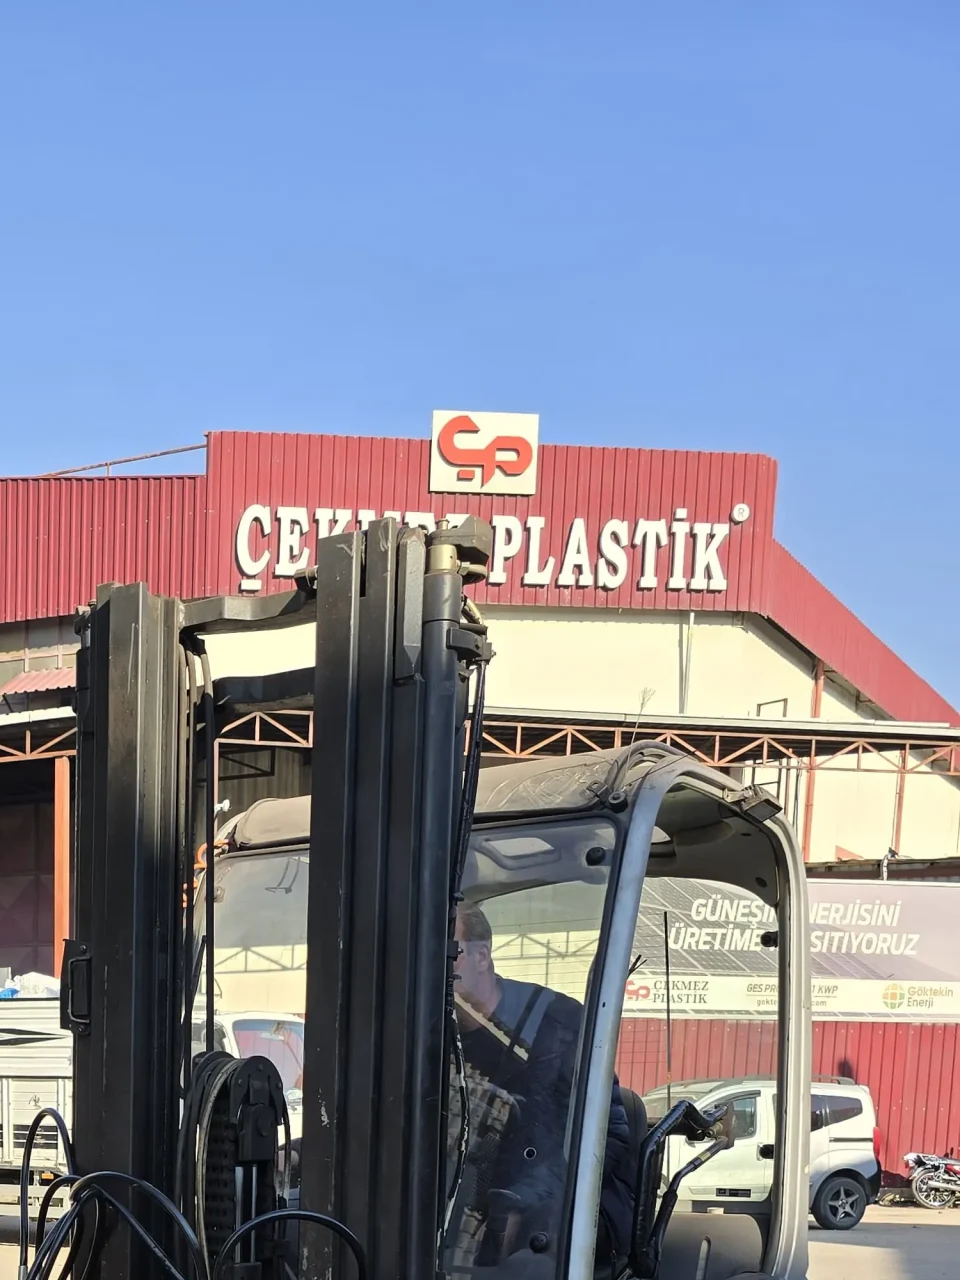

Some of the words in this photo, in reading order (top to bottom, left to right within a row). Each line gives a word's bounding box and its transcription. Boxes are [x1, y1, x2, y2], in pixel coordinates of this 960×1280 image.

[489, 509, 730, 591] PLASTİK
[908, 986, 954, 997] Göktekin
[907, 997, 934, 1009] Enerji
